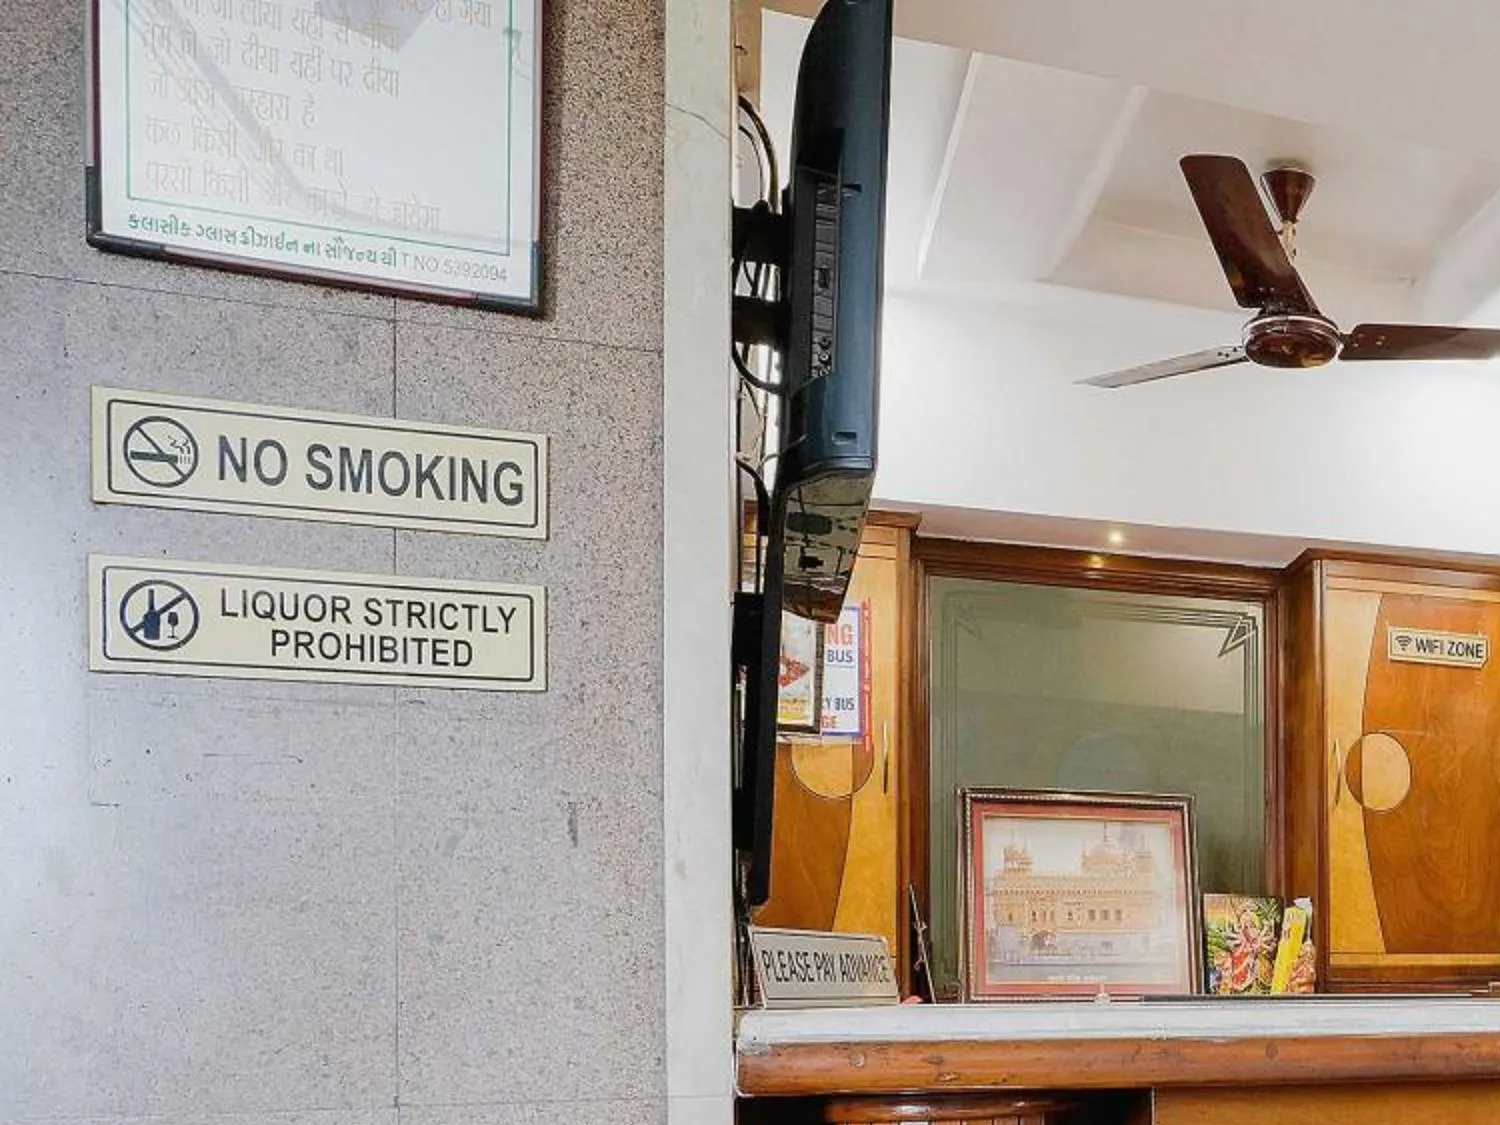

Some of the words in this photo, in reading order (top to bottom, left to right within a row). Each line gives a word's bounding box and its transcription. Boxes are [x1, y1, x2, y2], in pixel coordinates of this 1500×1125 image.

[218, 434, 289, 487] NO
[305, 443, 525, 507] SMOKING
[220, 587, 353, 626] LIQUOR
[363, 597, 518, 634] STRICTLY
[270, 628, 473, 668] PROHIBITED
[827, 623, 854, 646] NG
[1415, 637, 1445, 655] WIFI
[1447, 641, 1484, 659] ZONE
[827, 649, 854, 663] BUS
[761, 950, 815, 983] PLEASE
